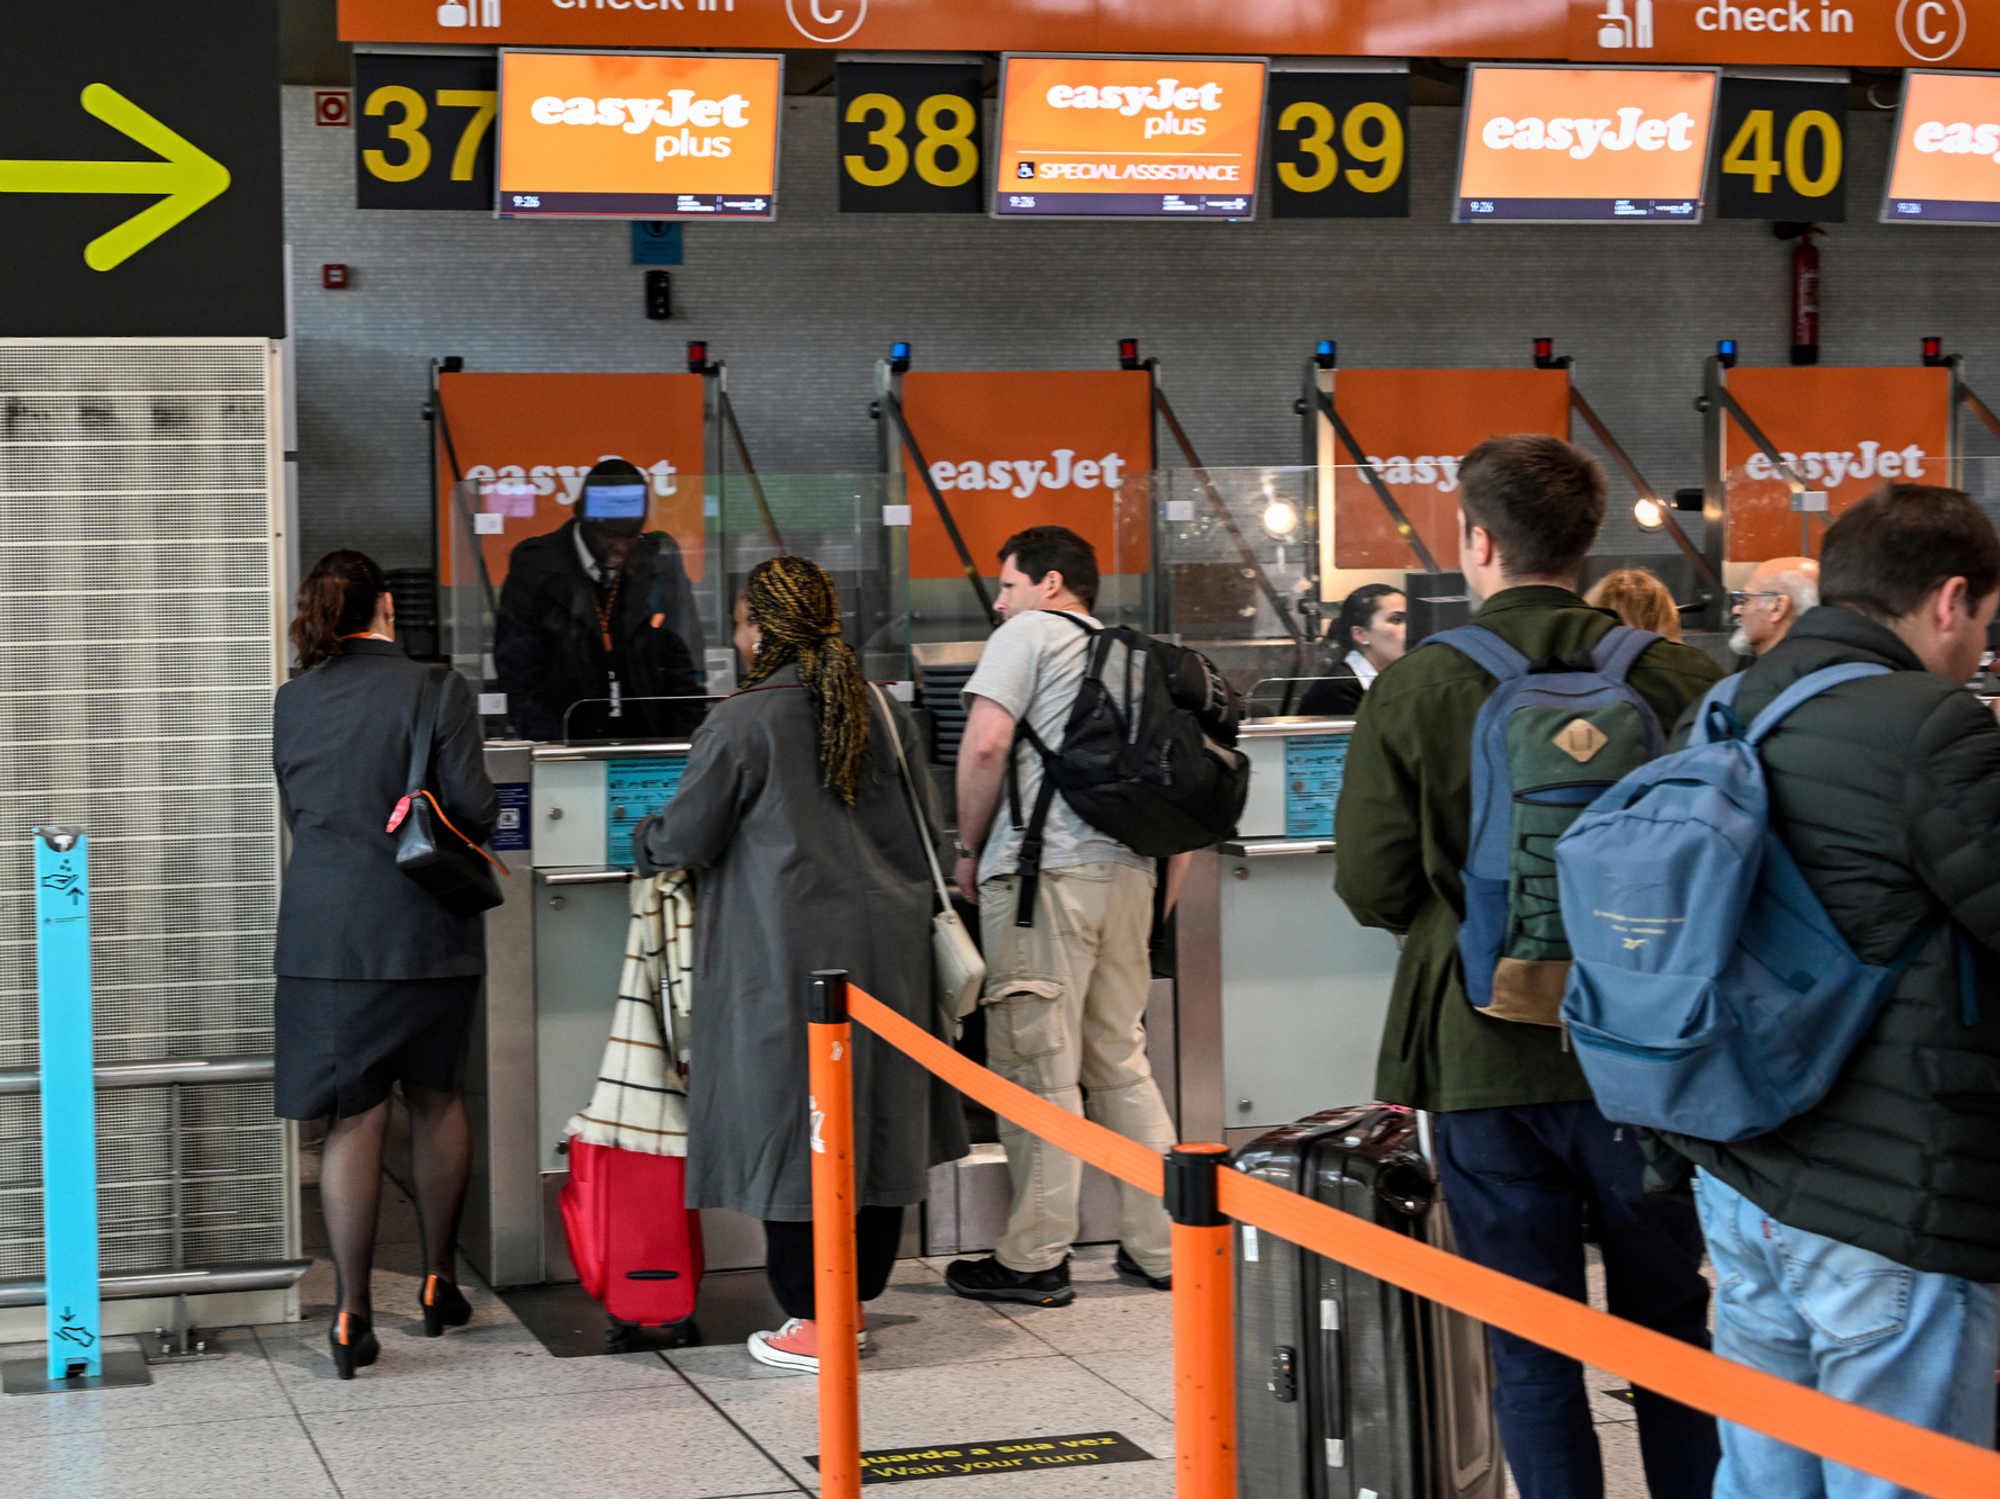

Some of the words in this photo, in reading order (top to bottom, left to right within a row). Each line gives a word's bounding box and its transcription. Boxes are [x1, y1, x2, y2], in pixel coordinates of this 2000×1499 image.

[1695, 0, 1811, 32] check
[1821, 0, 1854, 33] in
[1916, 1, 1947, 44] C
[531, 89, 750, 135] easyJet
[1046, 78, 1223, 116] easyJet
[363, 86, 497, 182] 37
[655, 128, 732, 162] plus
[844, 93, 979, 187] 38
[1144, 110, 1207, 139] plus
[1482, 107, 1695, 160] easyJet
[1913, 121, 2000, 165] eas
[1276, 102, 1404, 193] 39
[1722, 110, 1843, 197] 40
[1039, 163, 1122, 180] SPECIAL
[1122, 163, 1241, 181] ASSISTANCE
[466, 454, 678, 504] easyt
[928, 448, 1126, 499] easyJet
[871, 1464, 951, 1477] Wait
[953, 1458, 1023, 1473] your
[1030, 1452, 1099, 1465] turn
[968, 1448, 991, 1456] a
[996, 1443, 1056, 1453] sua
[1059, 1437, 1118, 1448] vez
